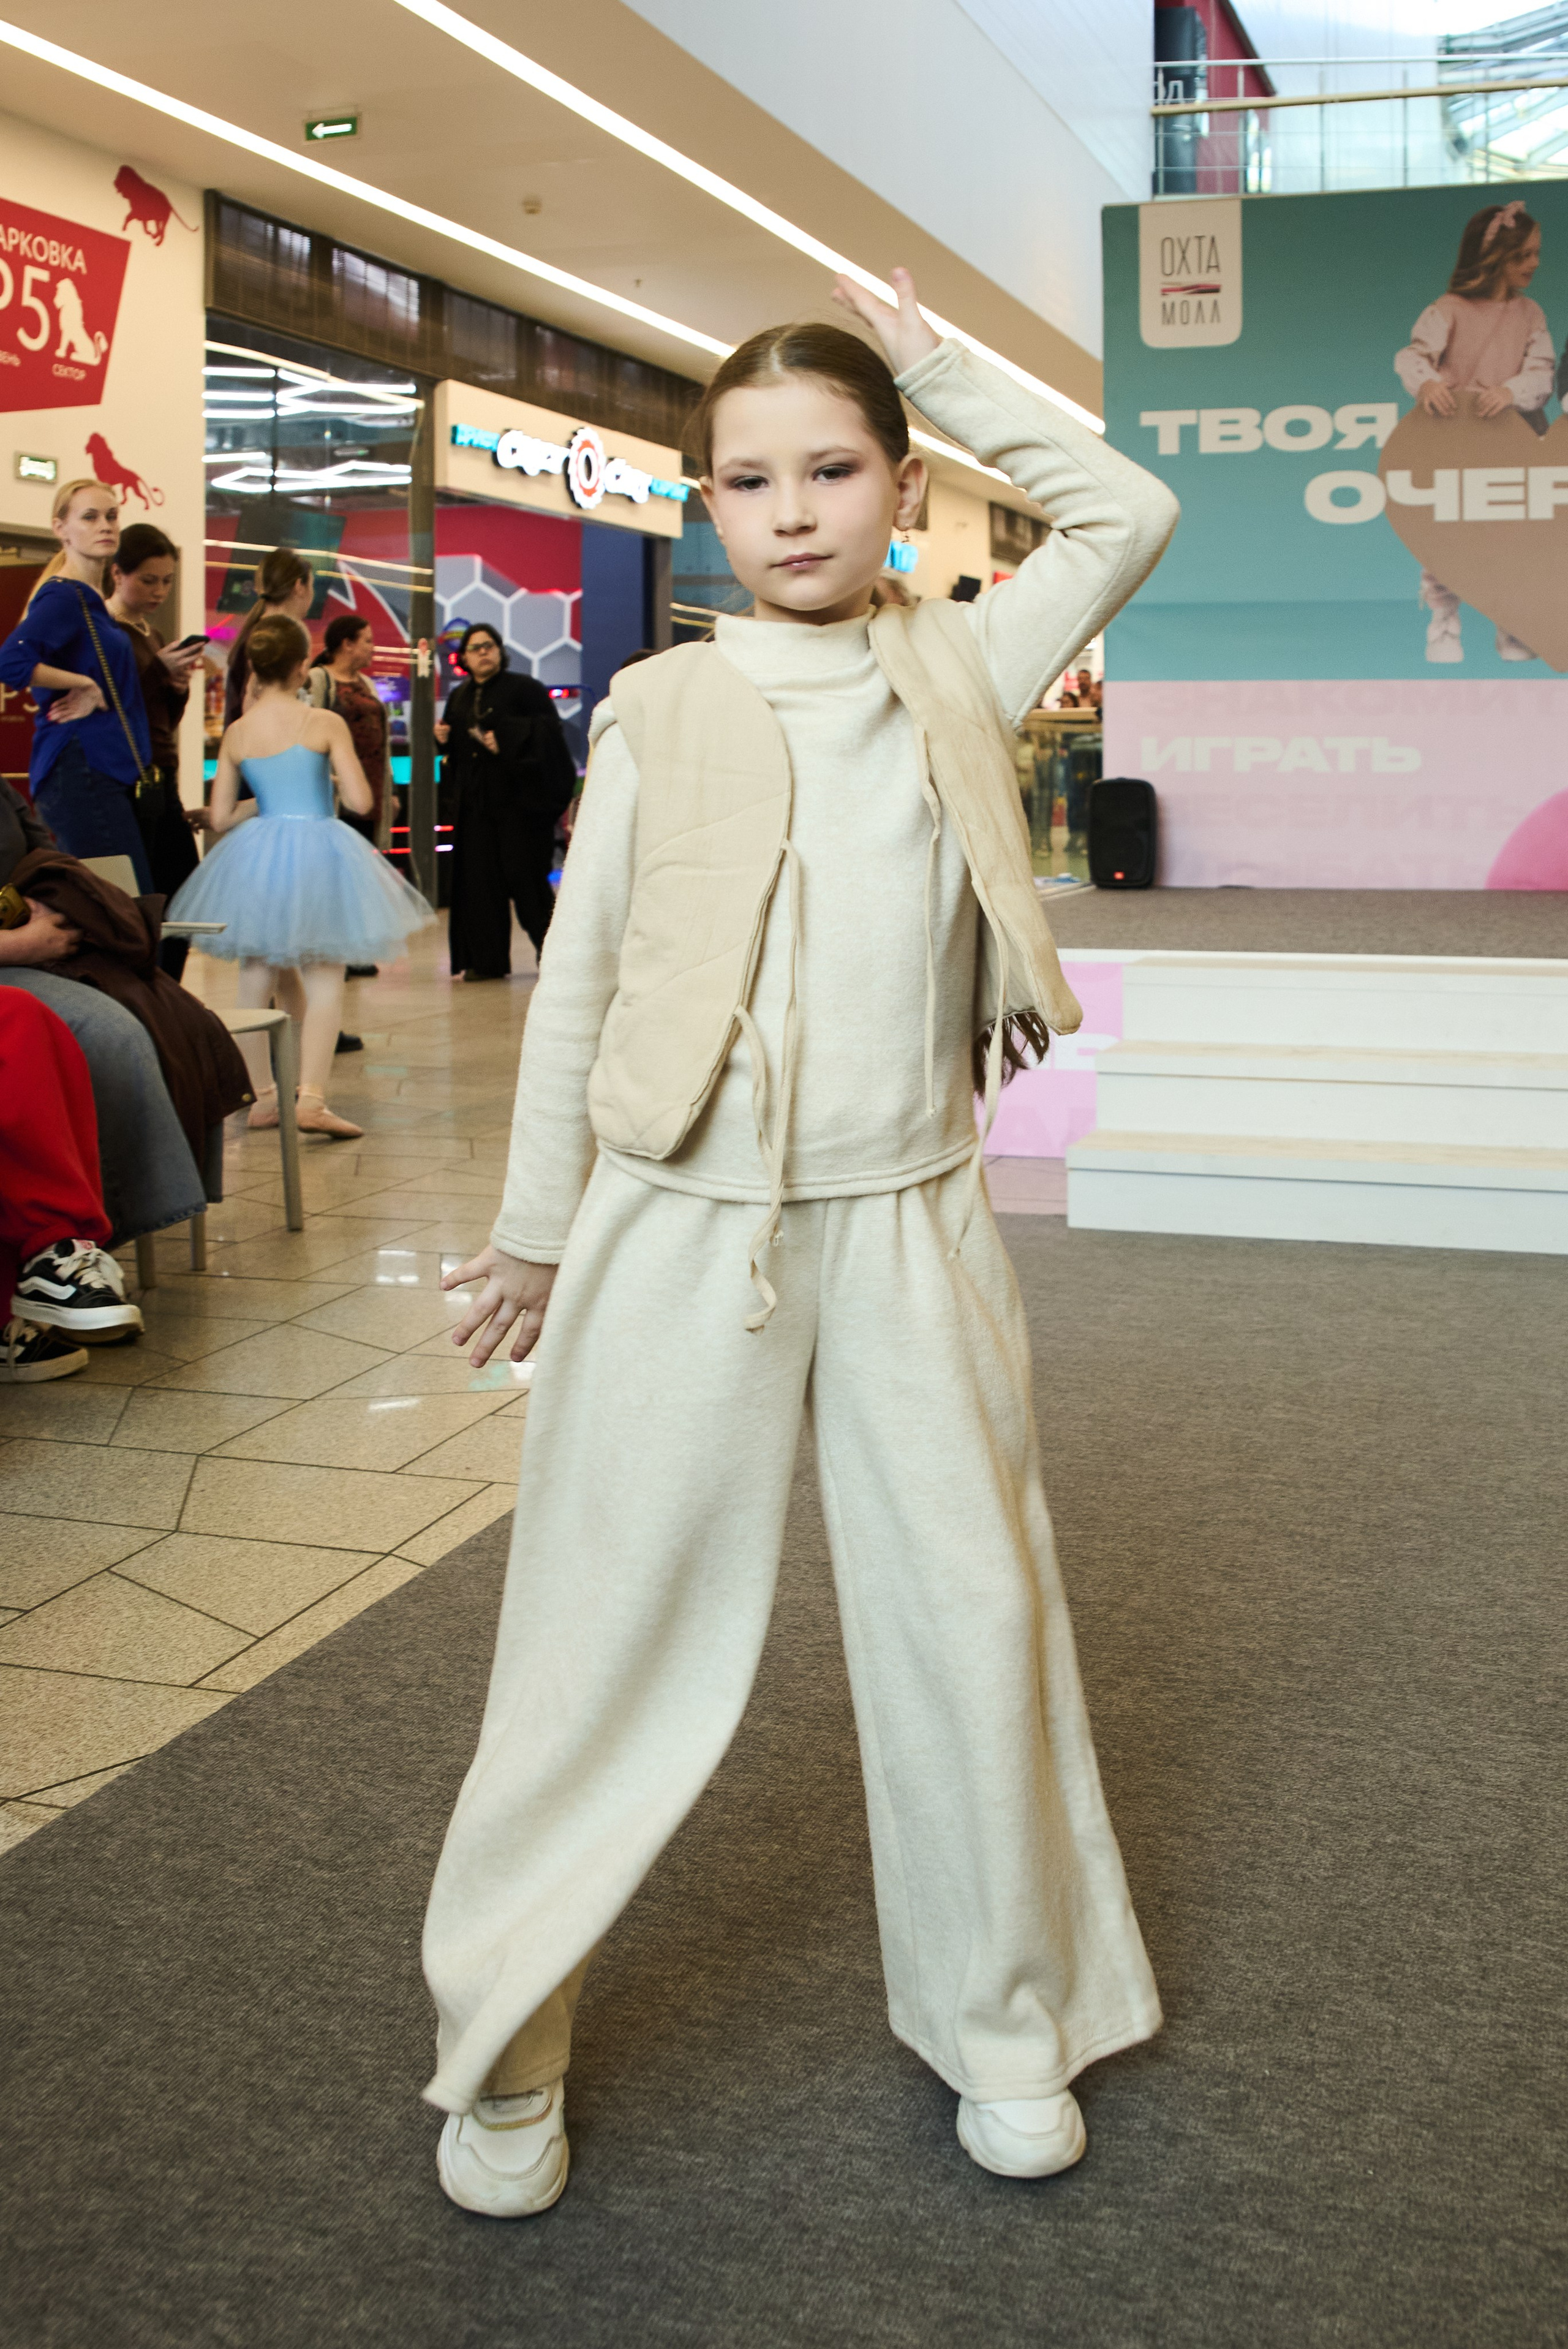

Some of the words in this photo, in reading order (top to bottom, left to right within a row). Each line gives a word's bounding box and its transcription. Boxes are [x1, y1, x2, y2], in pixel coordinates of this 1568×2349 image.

[1160, 235, 1221, 276] ОХТА
[1161, 300, 1221, 325] МОЛЛ
[1139, 402, 1398, 455] ТВОЯ
[1304, 466, 1568, 525] ОЧЕР
[1140, 736, 1422, 773] ИГРАТЬ
